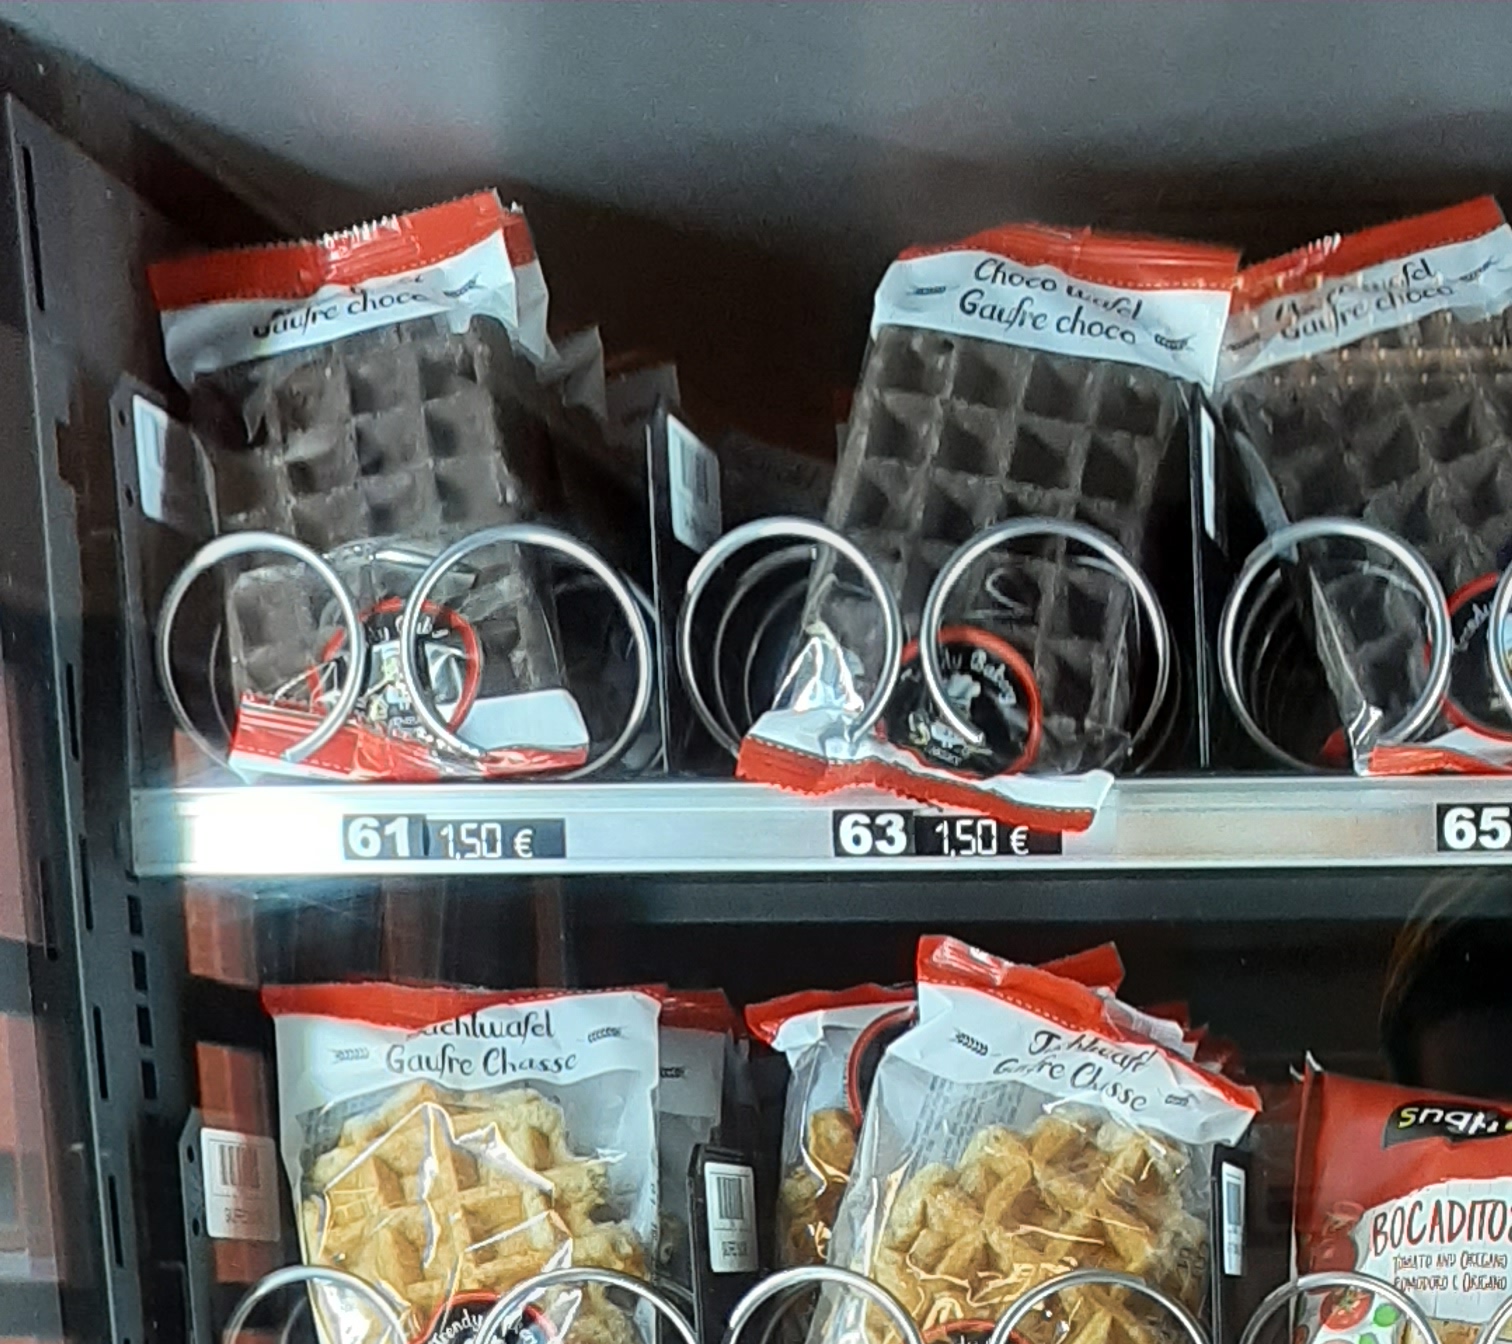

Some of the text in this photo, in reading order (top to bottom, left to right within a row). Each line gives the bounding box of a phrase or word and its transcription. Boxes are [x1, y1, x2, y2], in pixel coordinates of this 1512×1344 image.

[974, 257, 1057, 293] Choco
[958, 288, 1138, 346] Gaufre choco
[348, 817, 411, 858] 61
[440, 822, 534, 860] 1,50 €
[838, 813, 908, 856] 63
[1443, 807, 1512, 850] 65
[386, 1043, 578, 1077] Gaufre Chasse
[1436, 1252, 1457, 1270] AND
